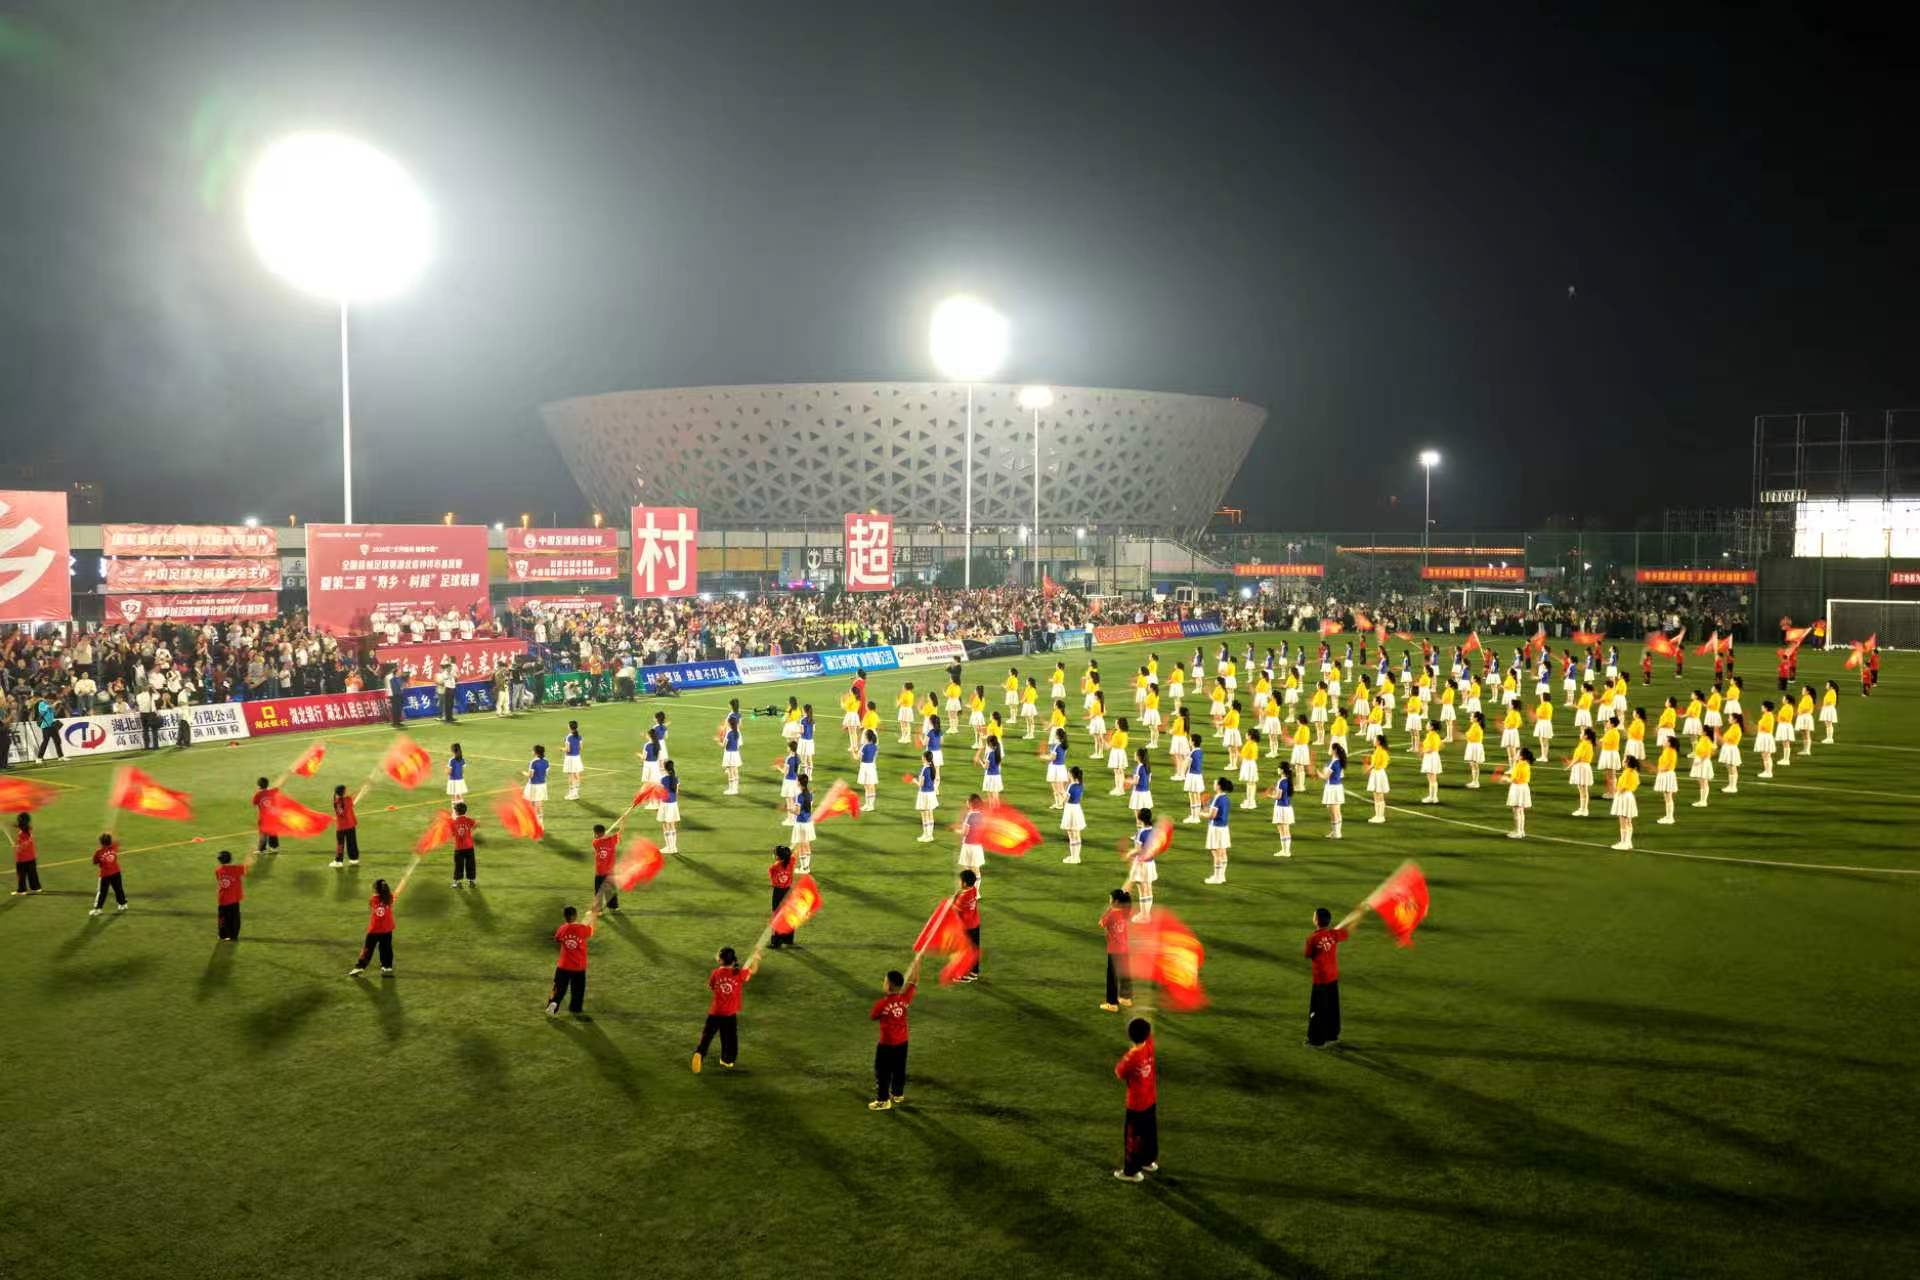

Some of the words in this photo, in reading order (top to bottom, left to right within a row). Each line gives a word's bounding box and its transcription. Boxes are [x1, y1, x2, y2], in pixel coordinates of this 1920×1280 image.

[636, 512, 695, 593] 村
[849, 519, 890, 586] 超
[289, 705, 324, 725] 湖北银行
